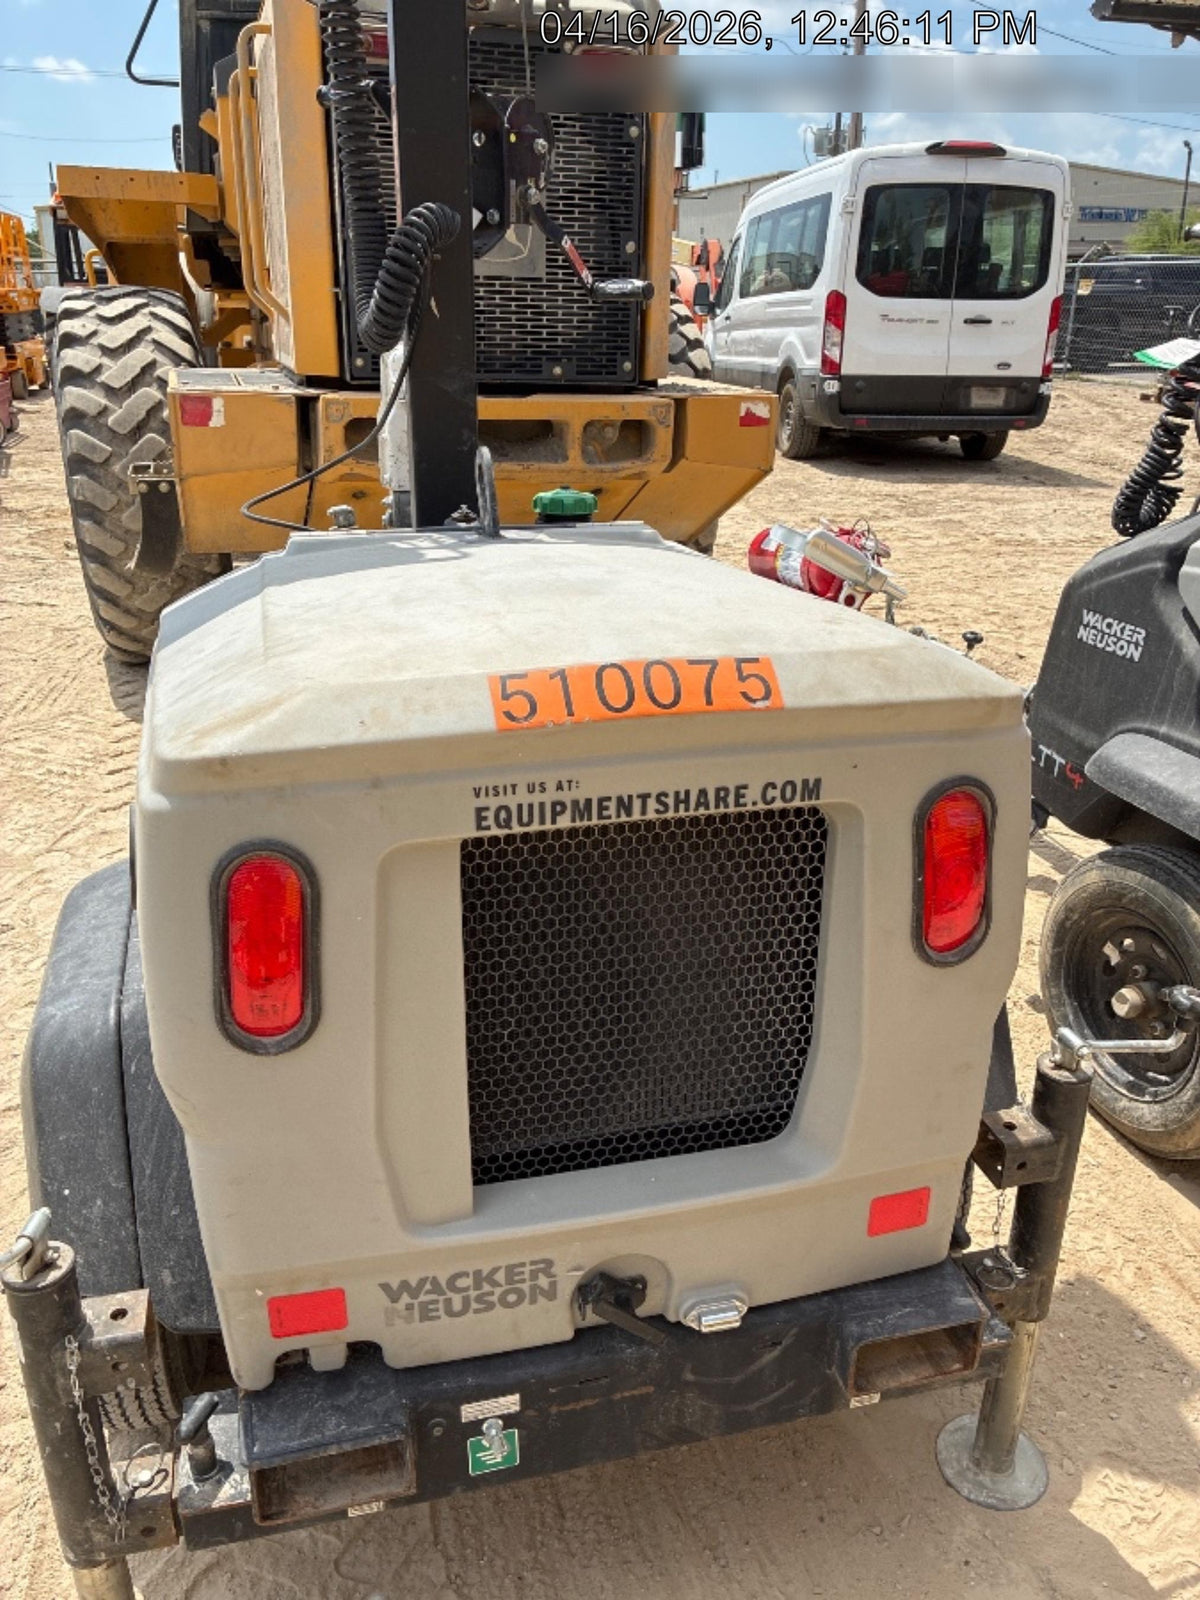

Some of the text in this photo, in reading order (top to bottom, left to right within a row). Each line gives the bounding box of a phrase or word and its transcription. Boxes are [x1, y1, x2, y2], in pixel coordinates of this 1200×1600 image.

[1077, 625, 1143, 663] NEUSON
[1082, 608, 1147, 646] WACKER
[500, 657, 773, 724] 510075
[473, 779, 580, 799] VISIT US AT:
[474, 777, 822, 832] EQUIPMENTSHARE.COM
[378, 1258, 557, 1304] WACKER
